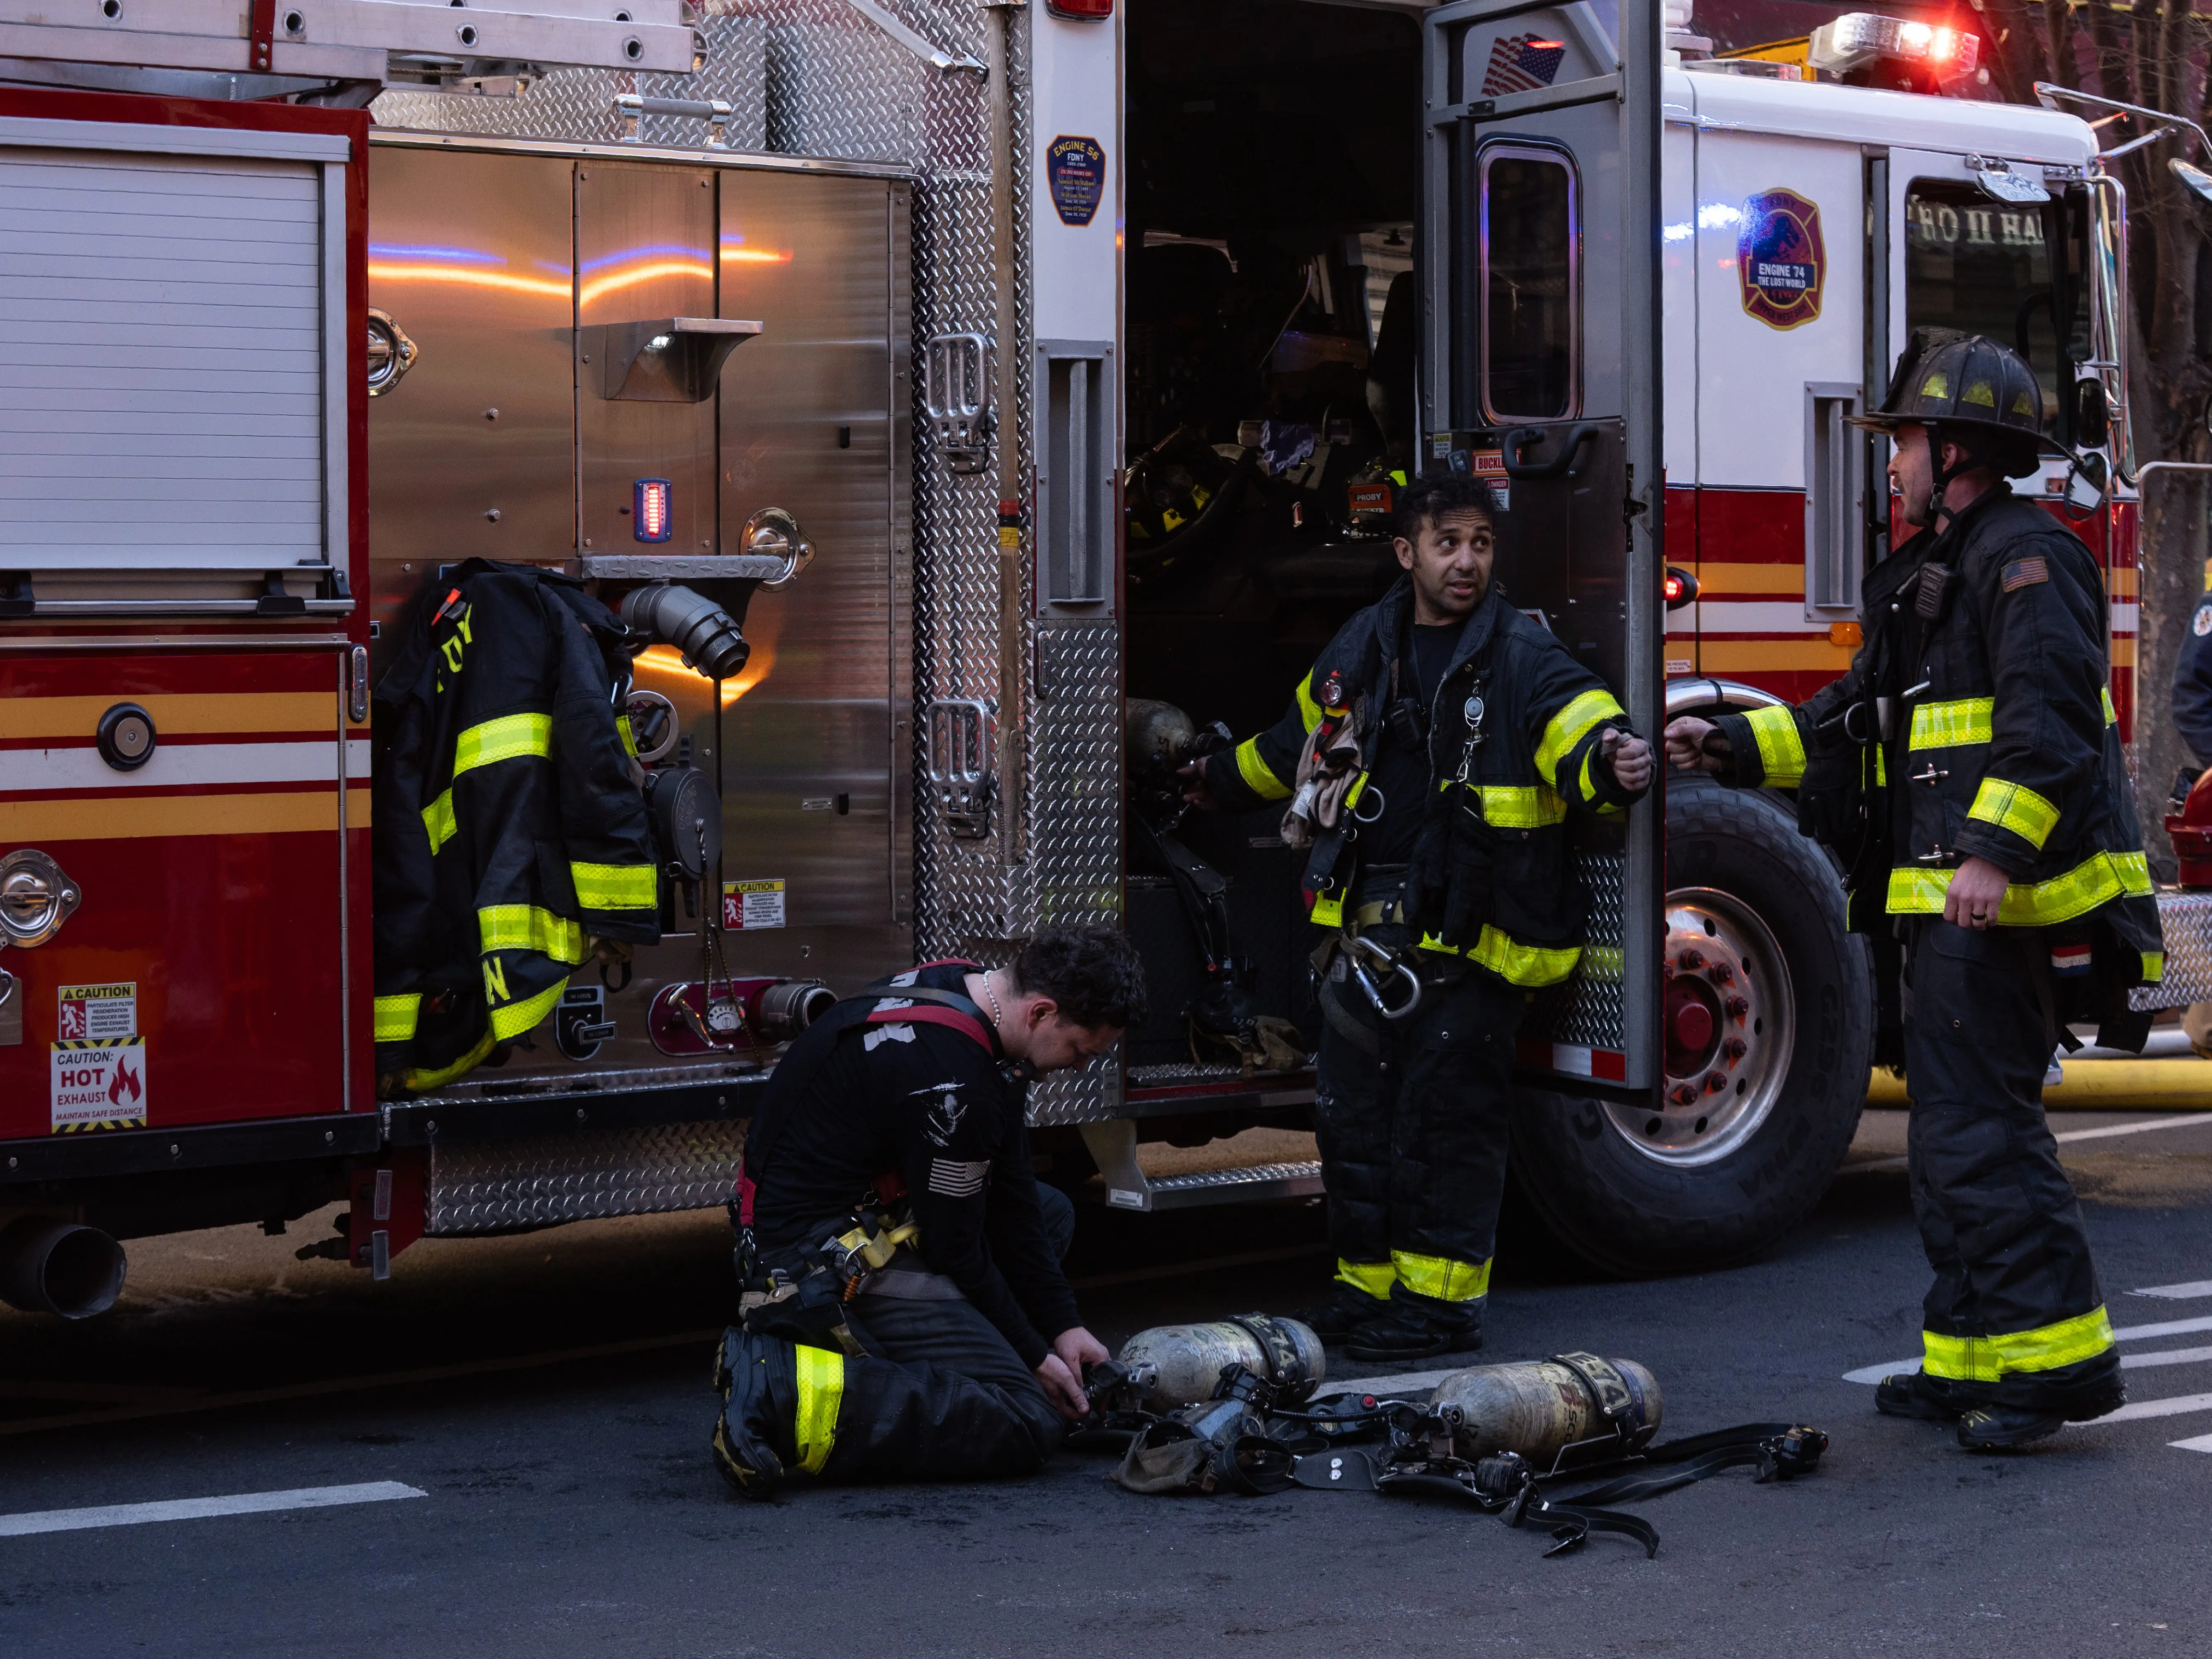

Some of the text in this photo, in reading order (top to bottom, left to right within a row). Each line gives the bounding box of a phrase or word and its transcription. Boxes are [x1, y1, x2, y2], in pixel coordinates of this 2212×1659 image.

[1054, 141, 1099, 160] ENGINE 56
[1068, 153, 1084, 161] FDNY
[1759, 263, 1805, 277] ENGINE 74
[1758, 277, 1806, 288] THE LOST WORLD
[1357, 493, 1382, 501] PROBY
[741, 883, 774, 892] CAUTION
[76, 986, 131, 999] CAUTION
[58, 1051, 113, 1065] CAUTION:
[61, 1068, 105, 1087] HOT
[57, 1092, 106, 1105] EXHAUST
[56, 1107, 143, 1121] MAINTAIN SAFE DISTANCE
[1567, 1354, 1626, 1404] E-74
